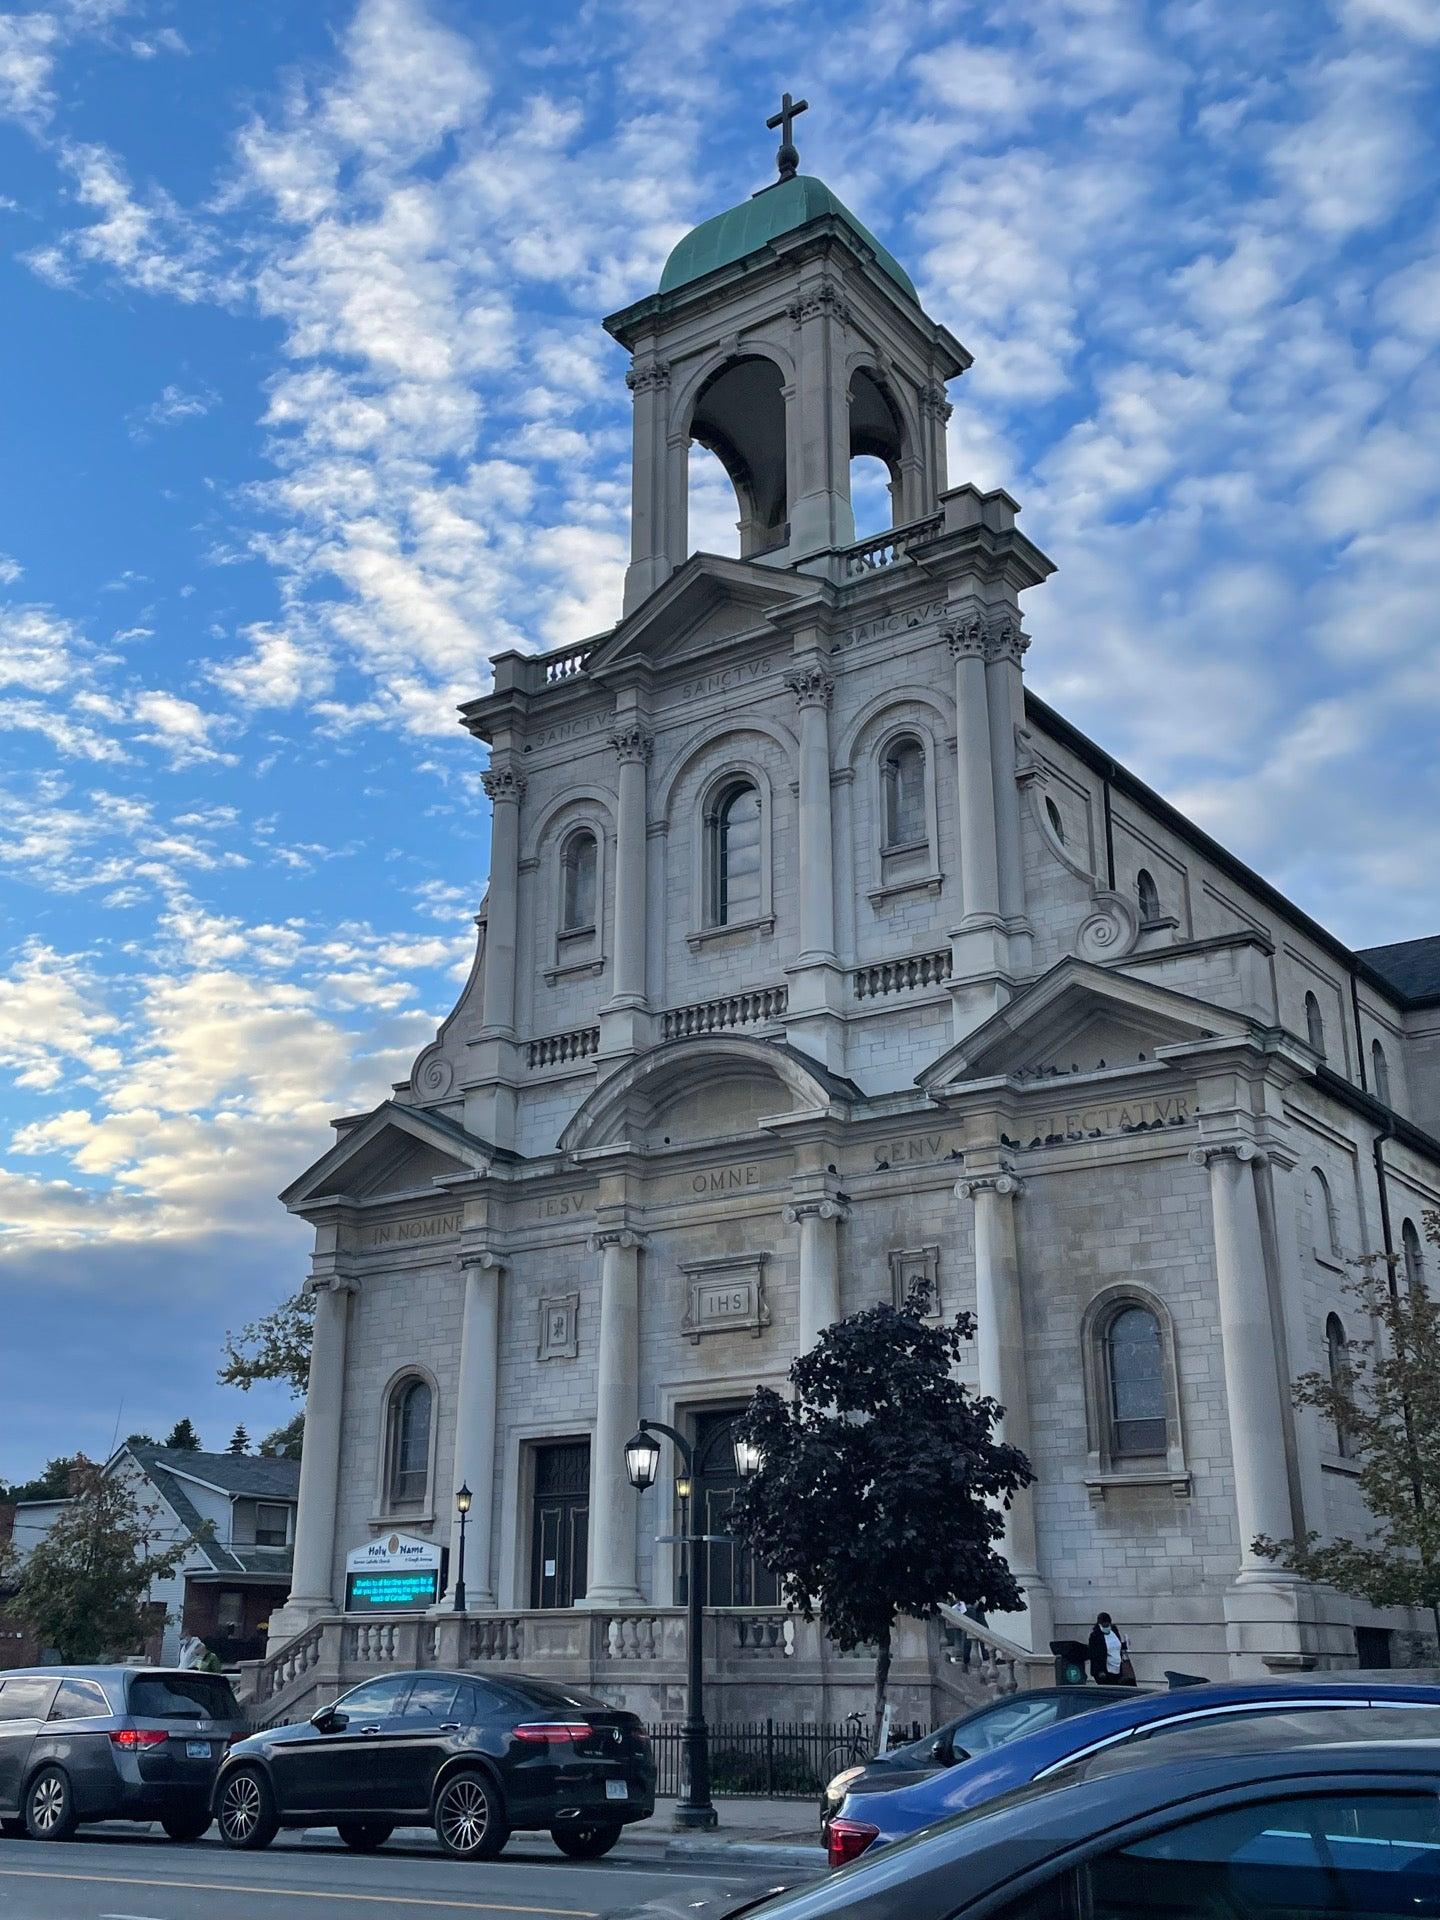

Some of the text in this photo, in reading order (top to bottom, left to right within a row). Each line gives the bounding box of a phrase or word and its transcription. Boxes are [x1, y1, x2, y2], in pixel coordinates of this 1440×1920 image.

[536, 601, 942, 746] SANCTVS SANCTVS SANCTVS
[373, 1227, 391, 1245] IN
[537, 1195, 585, 1219] IESV
[692, 1166, 759, 1193] OMNE
[709, 1294, 741, 1312] IHS
[368, 1545, 424, 1557] Holy Name
